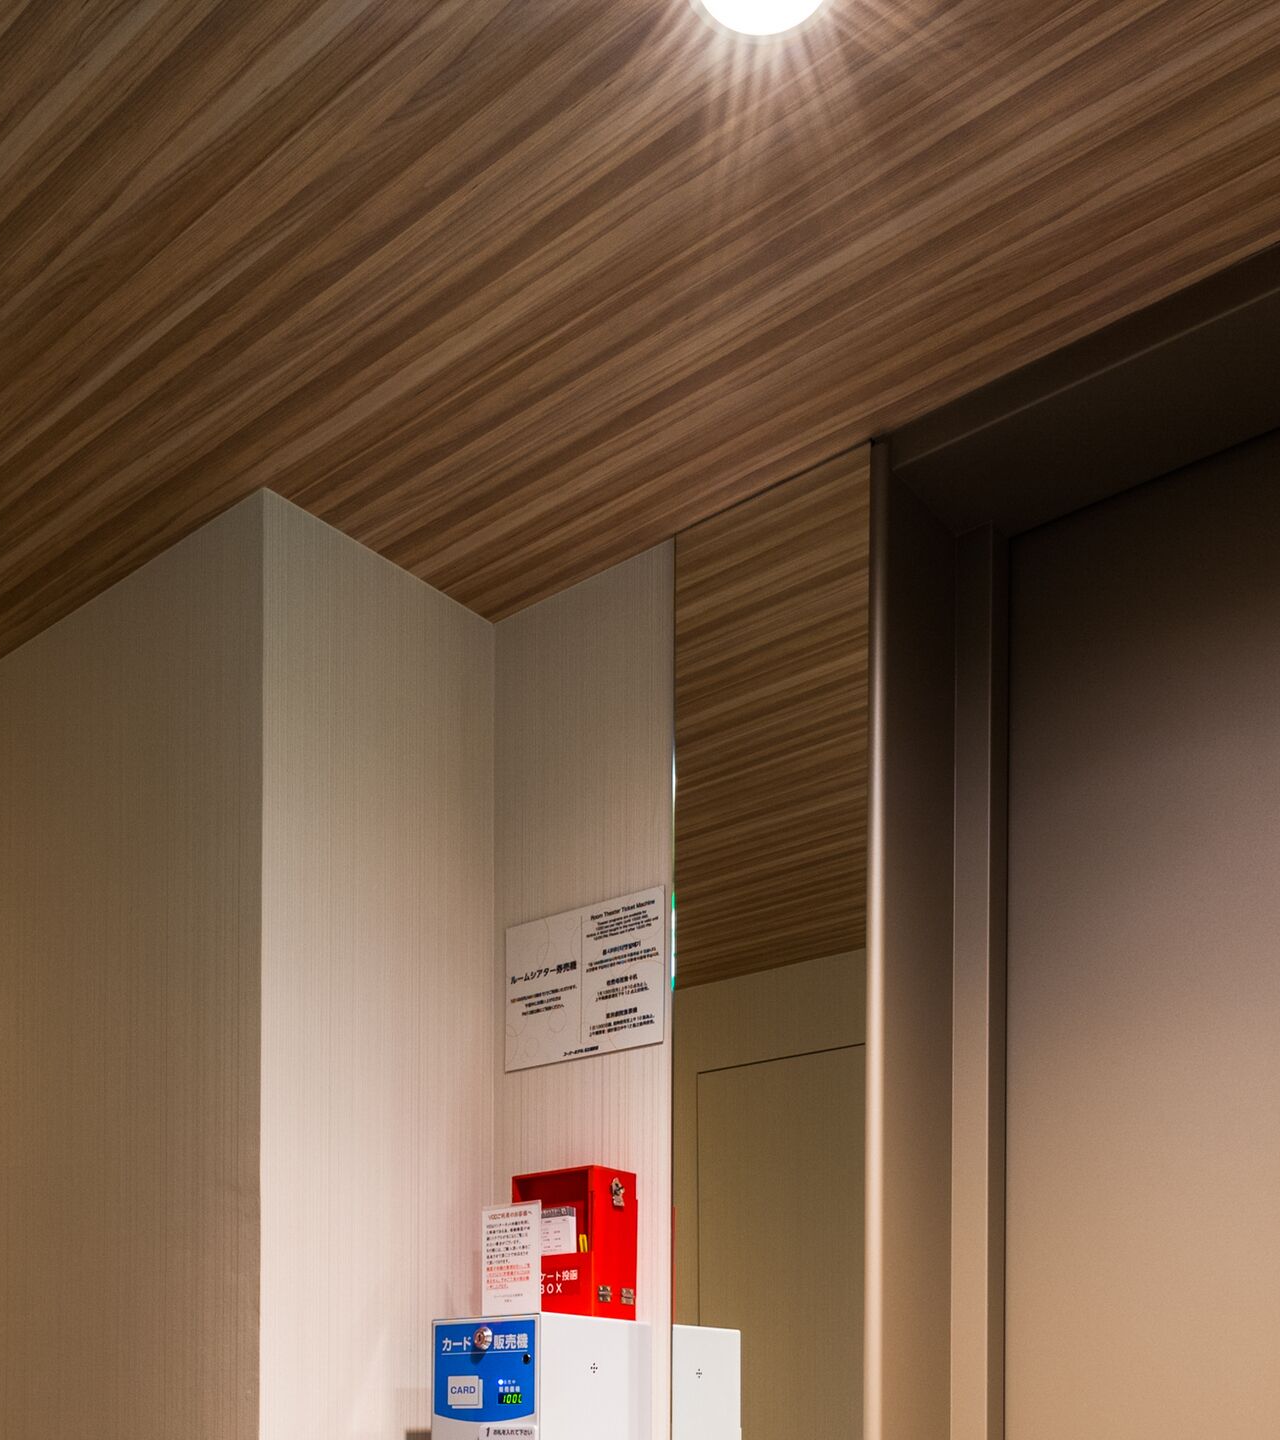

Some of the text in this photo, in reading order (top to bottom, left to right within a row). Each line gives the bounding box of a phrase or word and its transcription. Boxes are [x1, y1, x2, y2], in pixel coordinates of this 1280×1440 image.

[442, 1333, 529, 1352] カード 販売機
[450, 1385, 476, 1395] CARD
